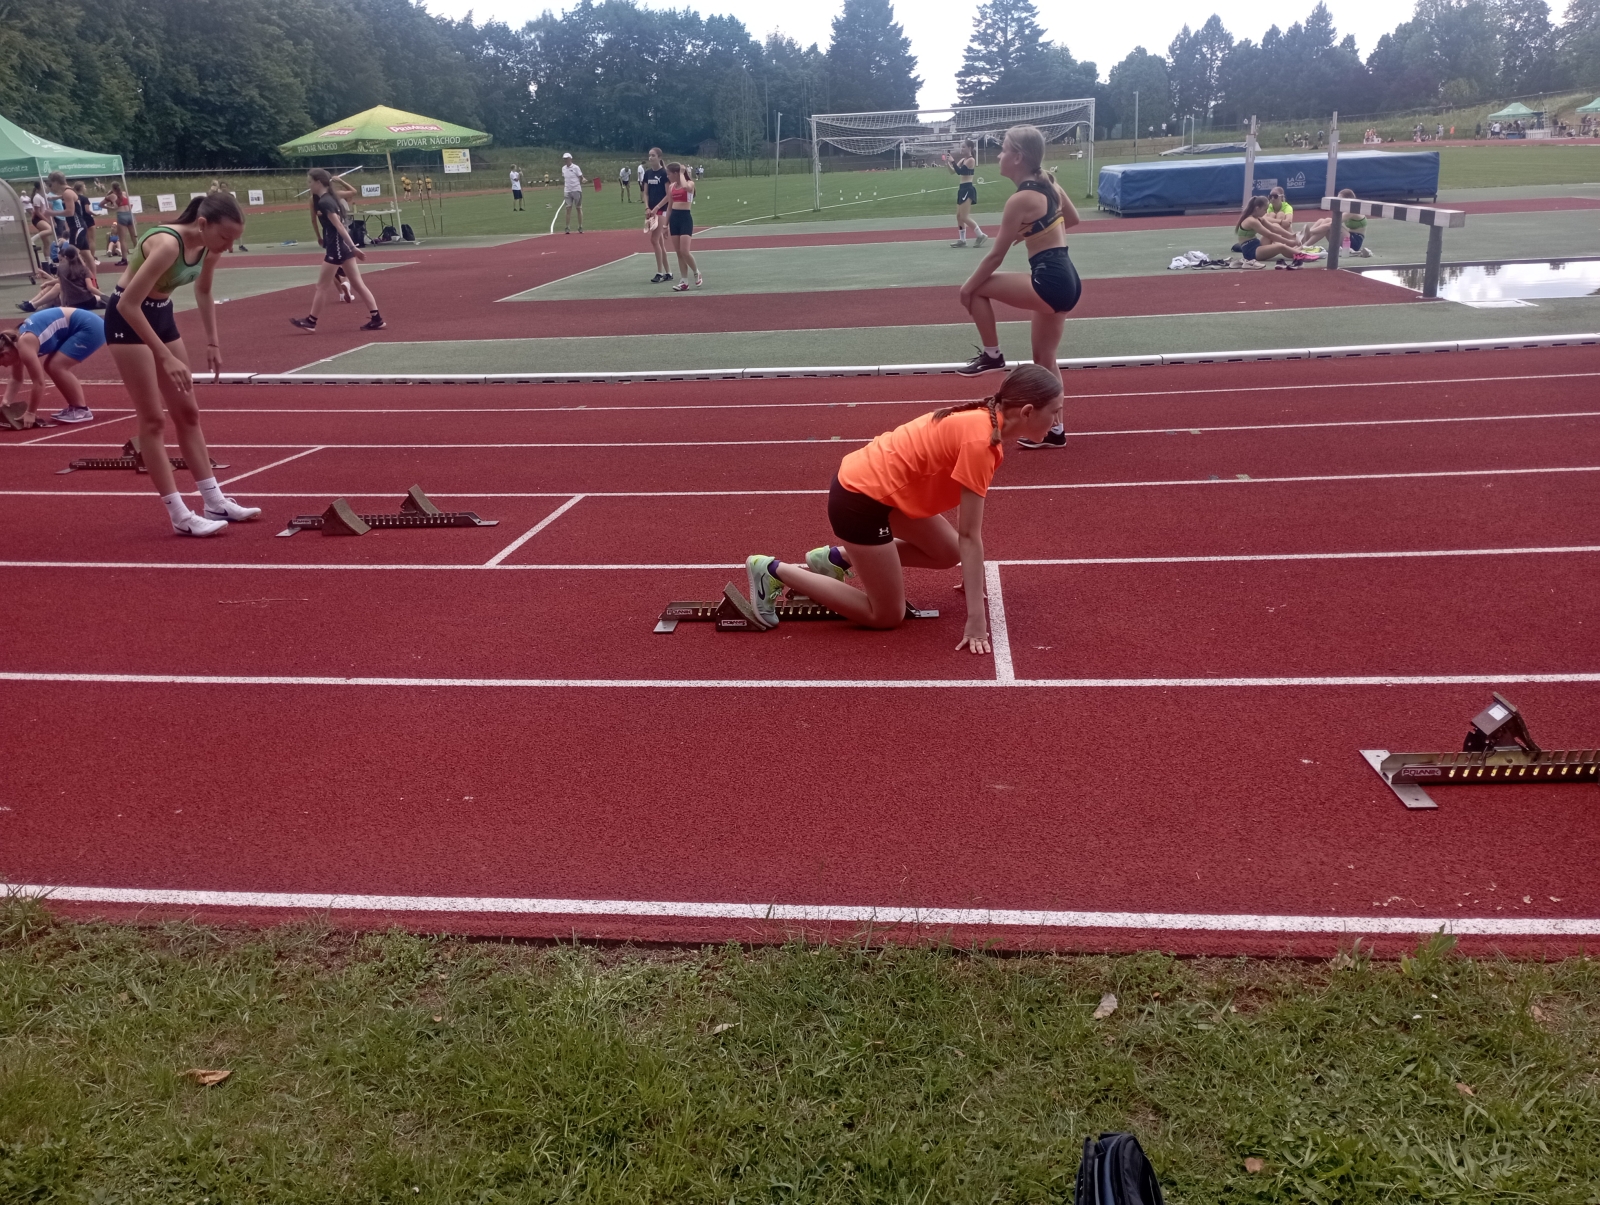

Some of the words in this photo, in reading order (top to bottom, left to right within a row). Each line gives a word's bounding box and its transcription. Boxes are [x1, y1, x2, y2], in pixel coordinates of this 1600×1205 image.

[396, 137, 428, 147] PIVOVAR
[429, 135, 461, 145] NÁCHOD
[297, 144, 317, 153] PIVOVAR
[1402, 768, 1440, 776] POLANIK
